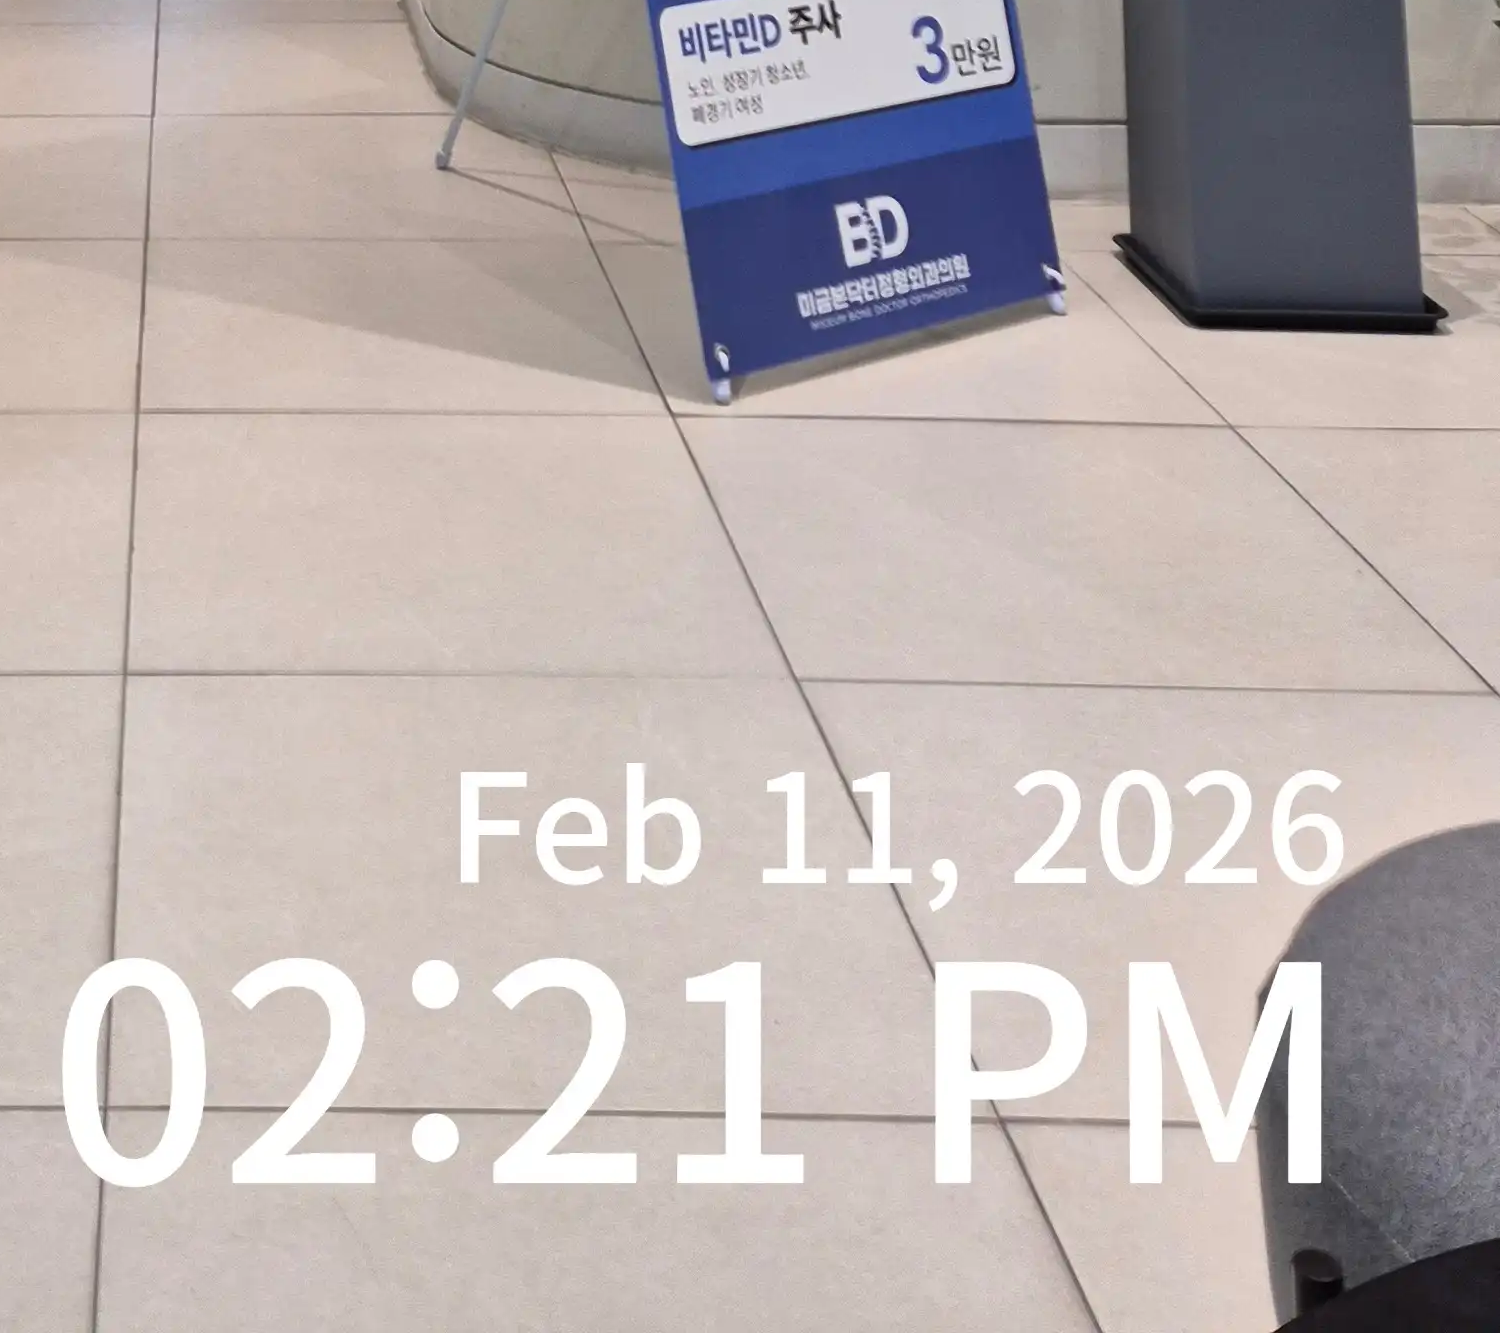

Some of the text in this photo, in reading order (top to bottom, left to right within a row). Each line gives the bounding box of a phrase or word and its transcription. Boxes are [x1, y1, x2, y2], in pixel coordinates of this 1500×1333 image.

[678, 13, 782, 64] 비타민D
[911, 15, 1002, 84] 3만원
[796, 253, 972, 319] 미금본닥터정형외과의원
